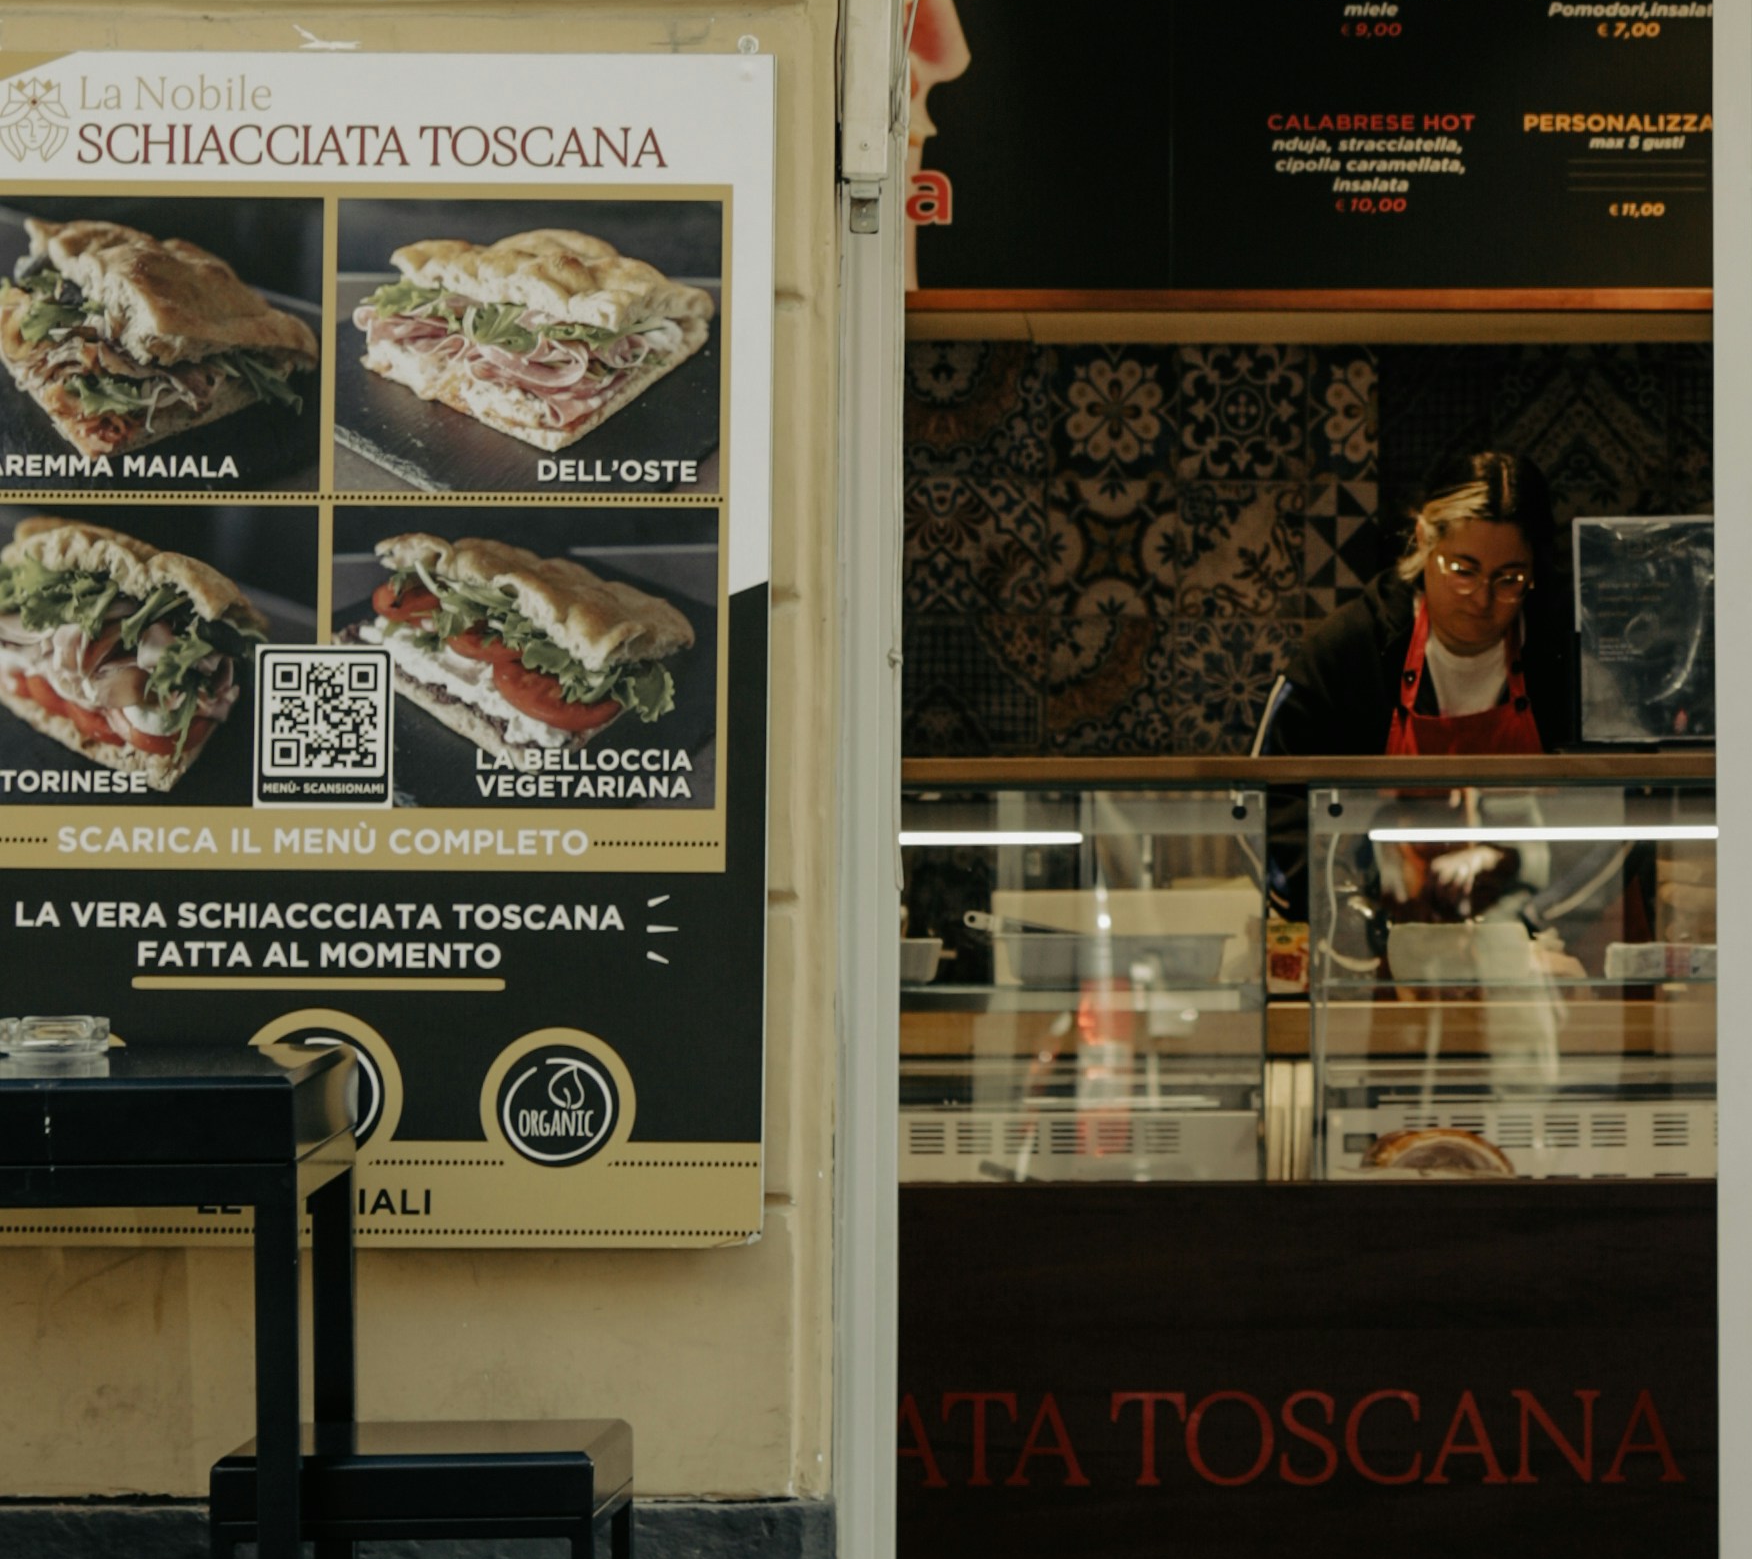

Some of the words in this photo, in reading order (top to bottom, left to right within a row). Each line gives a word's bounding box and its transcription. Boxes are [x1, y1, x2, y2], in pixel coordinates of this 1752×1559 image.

[1343, 2, 1399, 17] miele
[78, 76, 123, 112] La
[134, 74, 273, 113] Nobile
[1267, 113, 1415, 131] CALABRESE
[1424, 114, 1476, 131] HOT
[76, 122, 409, 168] SCHIACCIATA
[419, 125, 669, 170] TOSCANA
[1272, 137, 1332, 154] nduja,
[1338, 137, 1463, 154] stracciatella,
[1588, 136, 1625, 149] max
[1642, 135, 1686, 152] gusti
[1275, 157, 1341, 174] cipolla
[1346, 157, 1466, 174] caramellata,
[1332, 177, 1409, 192] insalata
[0, 454, 114, 478] REMMA
[123, 455, 240, 478] MAIALA
[536, 460, 698, 483] DELL'OSTE
[476, 748, 514, 770] LA
[524, 748, 693, 772] BELLOCCIA
[0, 769, 148, 794] TORINESE
[303, 782, 385, 794] SCANSIONAMI
[476, 774, 692, 798] VEGETARIANA
[58, 826, 218, 854] SCARICA
[231, 827, 262, 854] IL
[274, 821, 377, 855] MENÙ
[389, 827, 590, 857] COMPLETO
[14, 901, 60, 928] LA
[71, 901, 167, 929] VERA
[177, 901, 442, 931] SCHIACCCIATA
[453, 902, 625, 932] TOSCANA
[137, 941, 252, 968] FATTA
[263, 942, 309, 969] AL
[320, 942, 502, 970] MOMENTO
[518, 1109, 595, 1138] ORGANIC
[1110, 1388, 1687, 1487] TOSCANA
